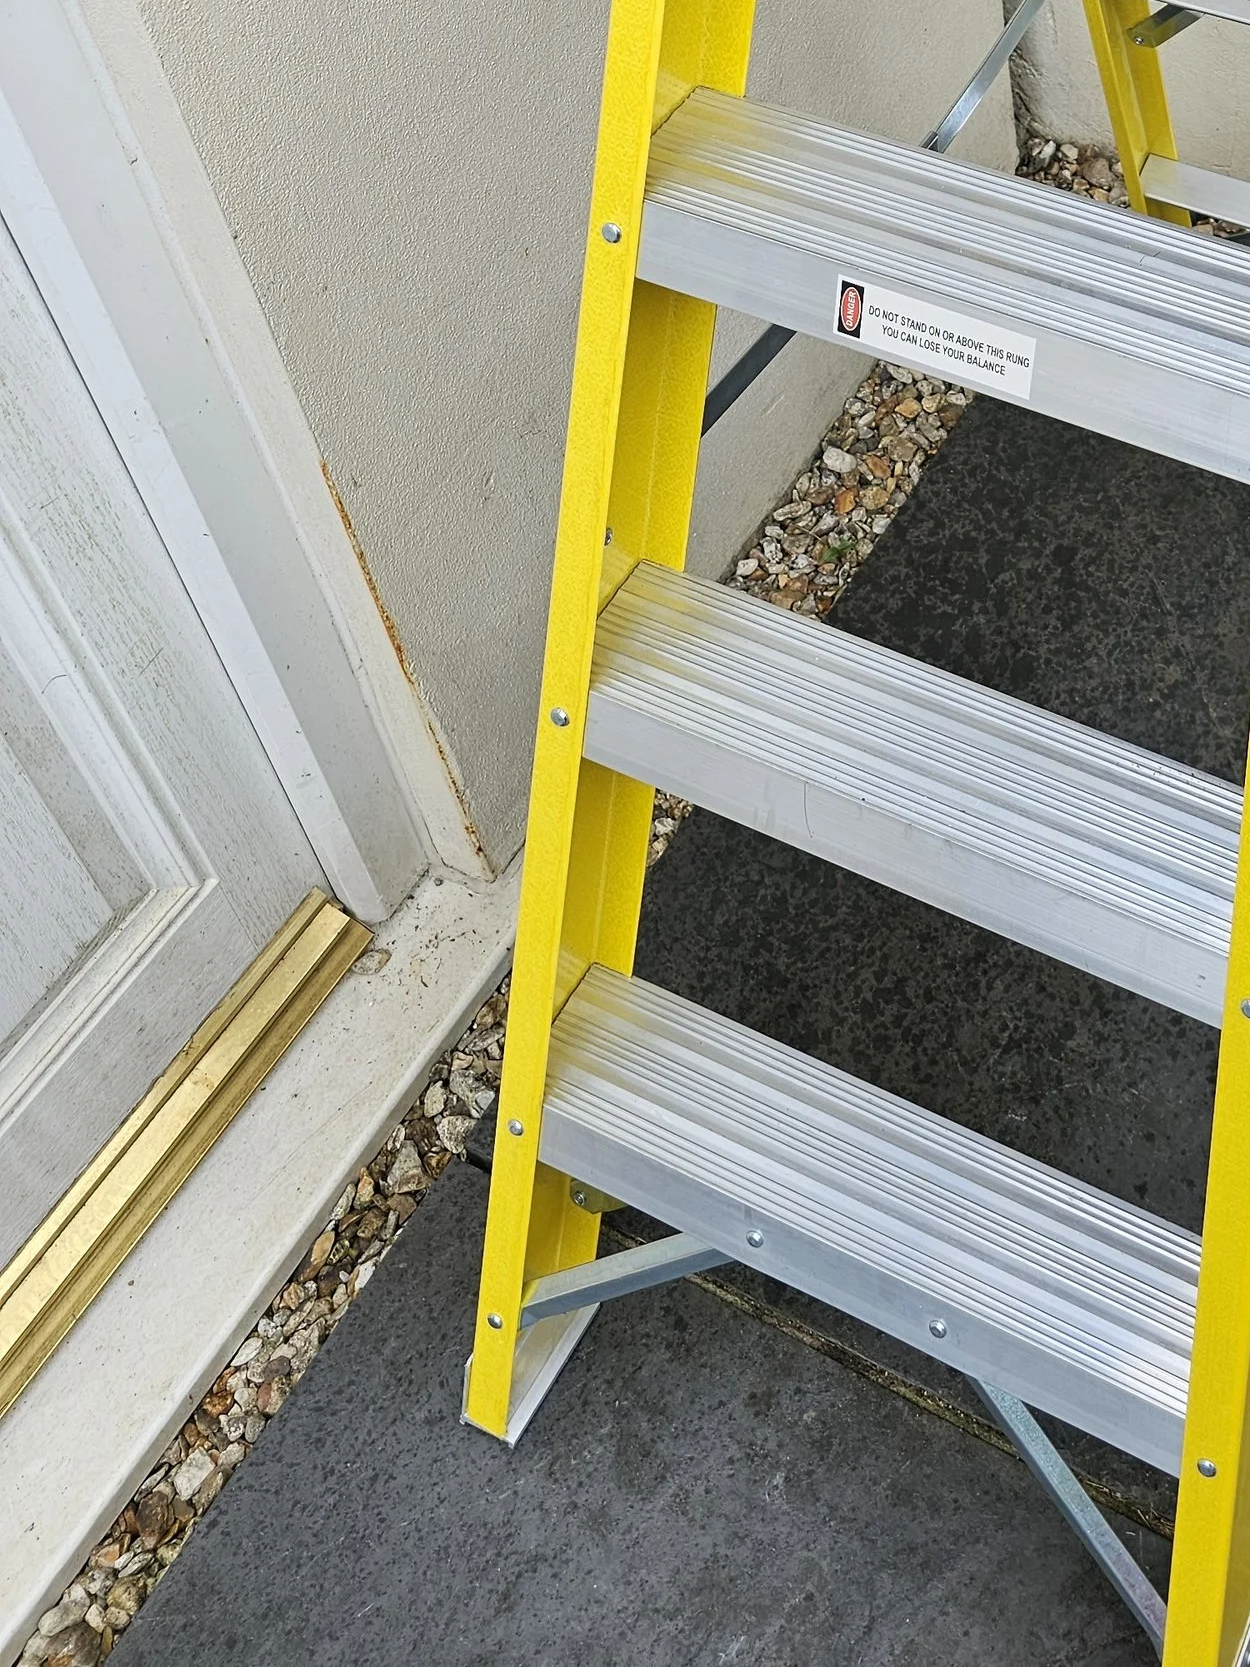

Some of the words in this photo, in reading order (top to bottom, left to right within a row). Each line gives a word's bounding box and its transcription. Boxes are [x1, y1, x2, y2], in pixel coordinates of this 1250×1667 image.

[845, 290, 857, 327] DANGER
[868, 305, 880, 317] DO
[882, 310, 899, 323] NOT
[900, 316, 927, 333] STAND
[929, 326, 940, 338] ON
[942, 330, 954, 342] OR
[956, 335, 984, 353] ABOVE
[986, 344, 1004, 359] THIS
[1006, 351, 1030, 368] RUNG
[882, 324, 899, 339] YOU
[900, 331, 917, 345] CAN
[919, 337, 941, 353] LOSE
[942, 344, 965, 362] YOUR
[966, 354, 1006, 376] BALANCE
